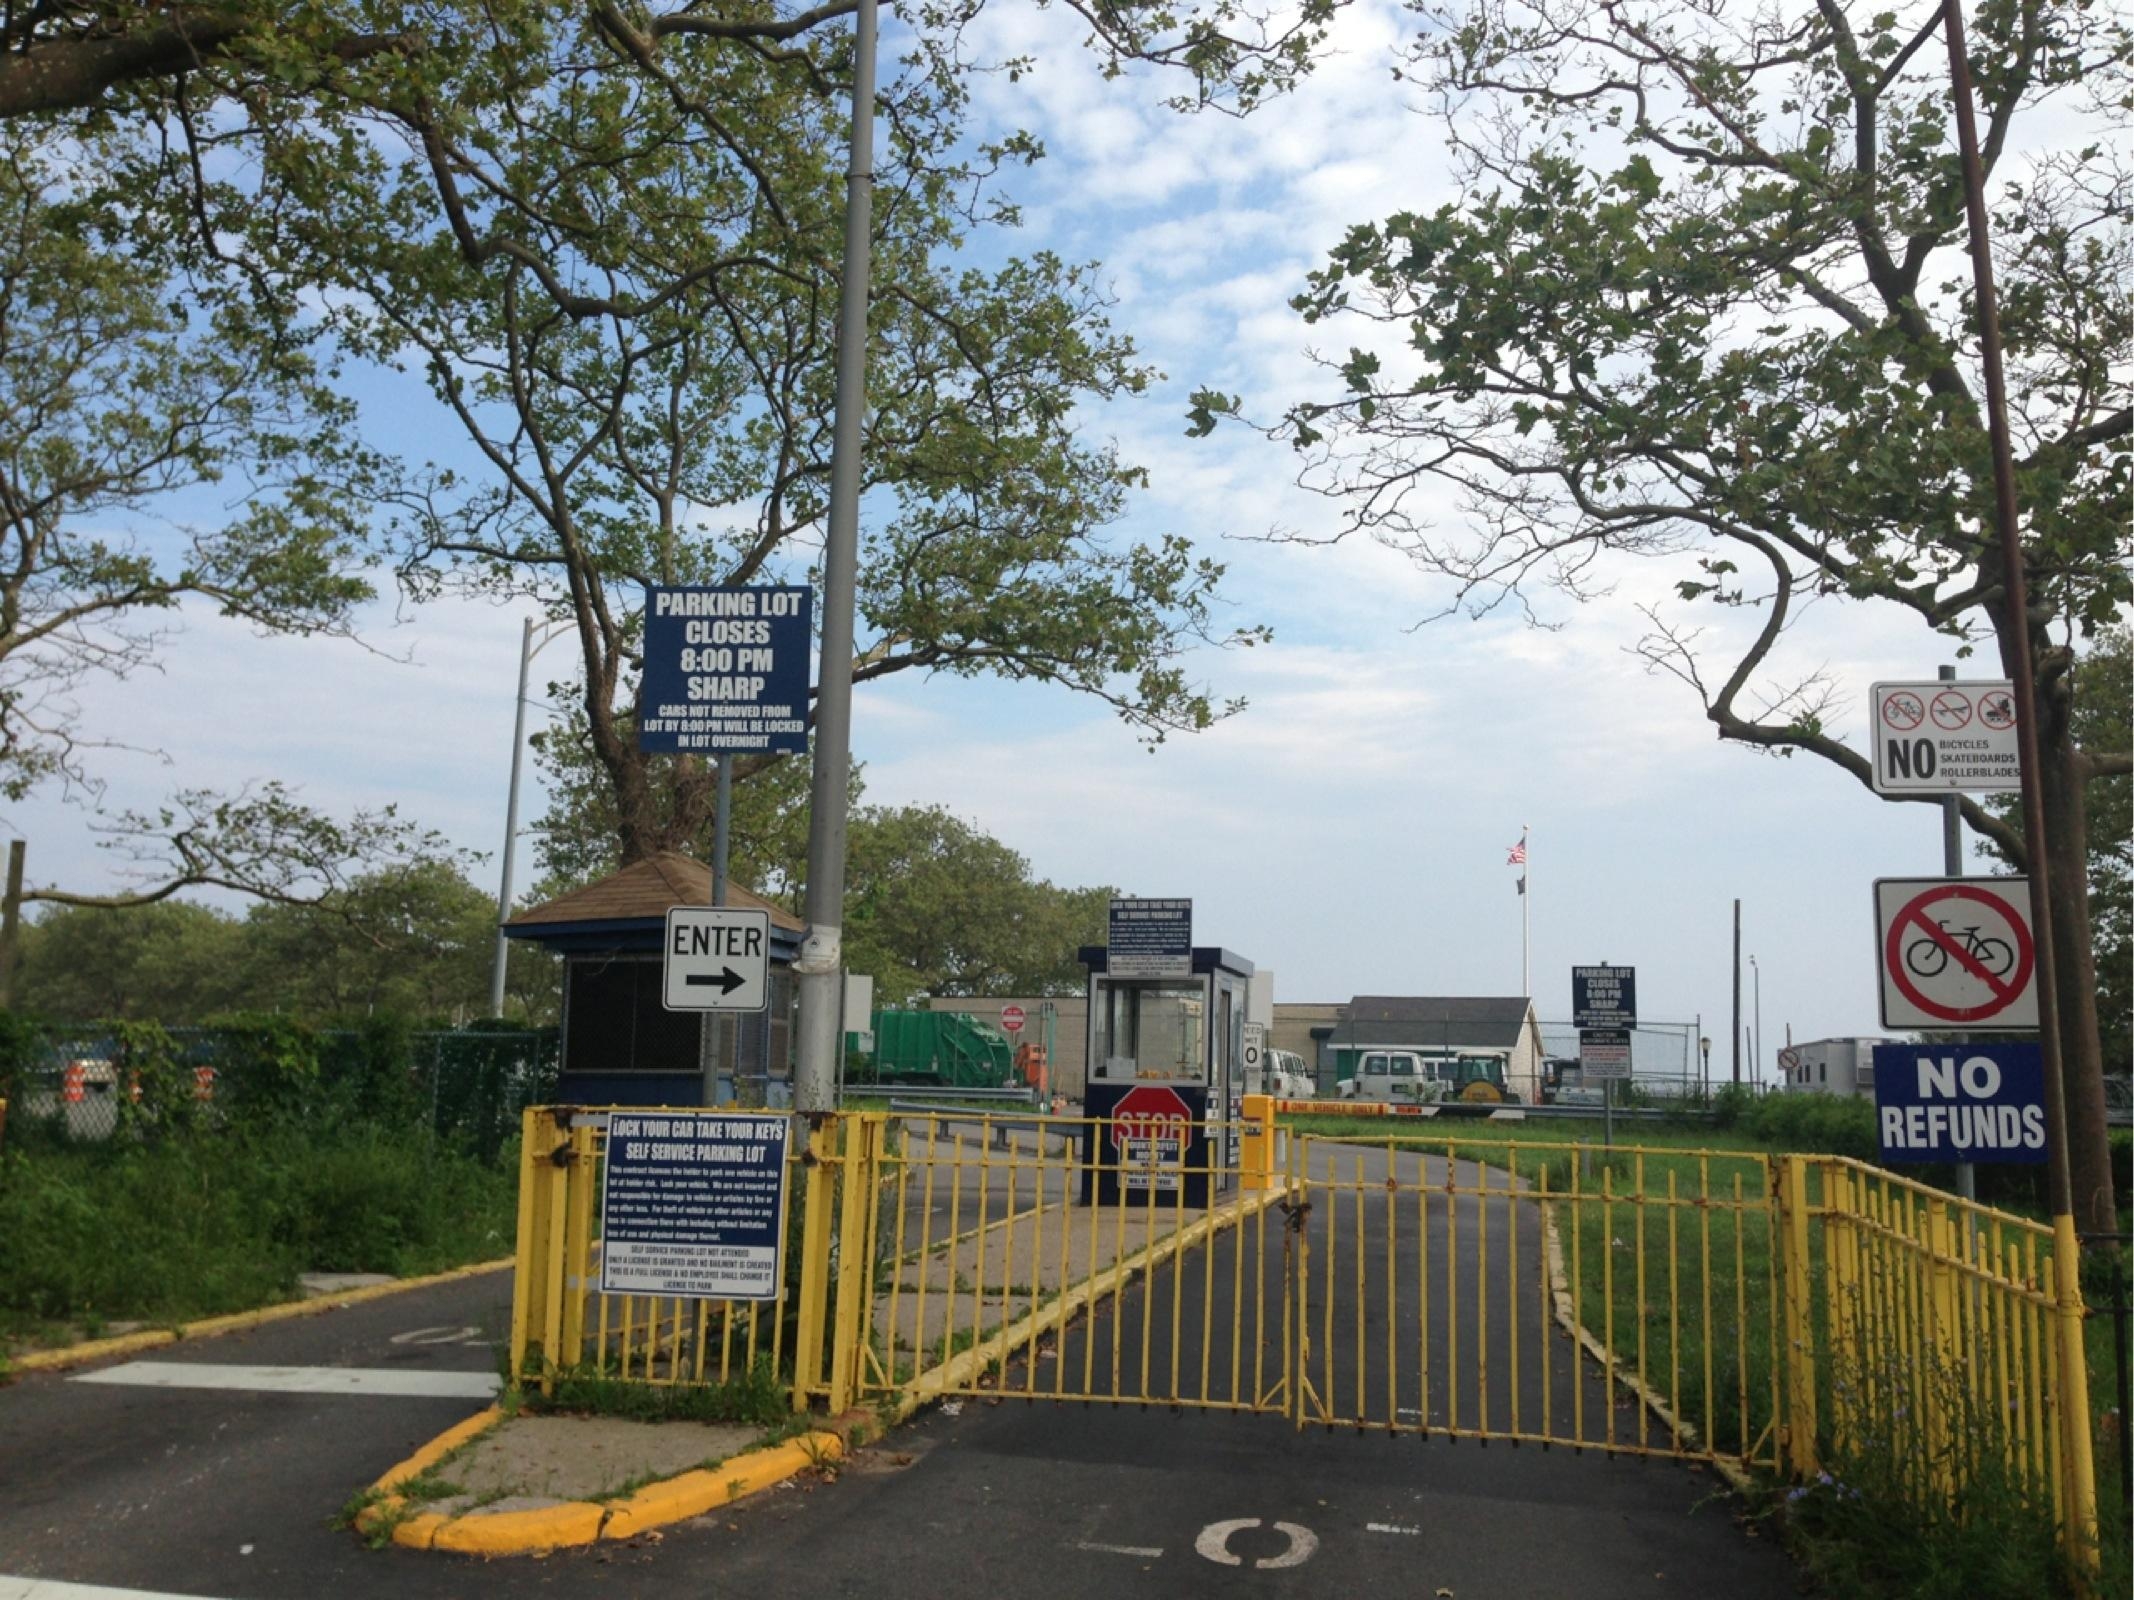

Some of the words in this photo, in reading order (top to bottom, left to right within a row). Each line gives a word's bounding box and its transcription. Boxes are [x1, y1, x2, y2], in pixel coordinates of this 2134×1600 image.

[656, 592, 756, 616] PARKING
[761, 592, 802, 616] LOT
[685, 621, 771, 644] CLOSES
[680, 648, 732, 672] 8:00
[737, 648, 773, 672] PM
[687, 676, 765, 700] SHARP
[658, 705, 688, 717] CARS
[690, 705, 709, 717] NOT
[712, 705, 760, 717] REMOVED
[762, 705, 791, 717] FROM
[645, 720, 662, 732] LOT
[666, 720, 679, 732] BY
[681, 720, 704, 732] 8:00
[706, 720, 722, 732] PM
[724, 720, 749, 732] WILL
[752, 720, 763, 732] BE
[765, 720, 804, 732] LOCKED
[678, 735, 688, 747] IN
[691, 735, 709, 747] LOT
[712, 735, 769, 747] OVERNIGHT
[1887, 738, 1936, 779] NO
[1940, 740, 1989, 749] BICYCLES
[1941, 754, 2016, 763] SKATEBOARDS
[1941, 768, 2021, 777] ROLLERBLADES
[673, 924, 762, 957] ENTER
[1576, 967, 1614, 978] PARKING
[1615, 968, 1631, 978] LOT
[1588, 979, 1620, 988] CLOSES
[1608, 989, 1622, 999] PM
[1590, 1000, 1619, 1009] SHARP
[1246, 1047, 1258, 1063] 0
[1917, 1056, 2002, 1099] NO
[1291, 1103, 1308, 1112] ONE
[1313, 1103, 1346, 1113] VEHICLE
[1351, 1104, 1374, 1114] ONLY
[613, 1119, 640, 1137] LOCK
[642, 1120, 669, 1138] YOUR
[672, 1121, 694, 1138] CAR
[697, 1121, 722, 1139] TAKE
[724, 1122, 752, 1140] YOUR
[755, 1122, 783, 1140] KEYS
[1120, 1112, 1186, 1138] STOP
[1881, 1104, 2046, 1149] REFUNDS
[626, 1143, 649, 1160] SELF
[651, 1143, 695, 1161] SERVICE
[697, 1145, 743, 1162] PARKING
[746, 1146, 766, 1163] LOT
